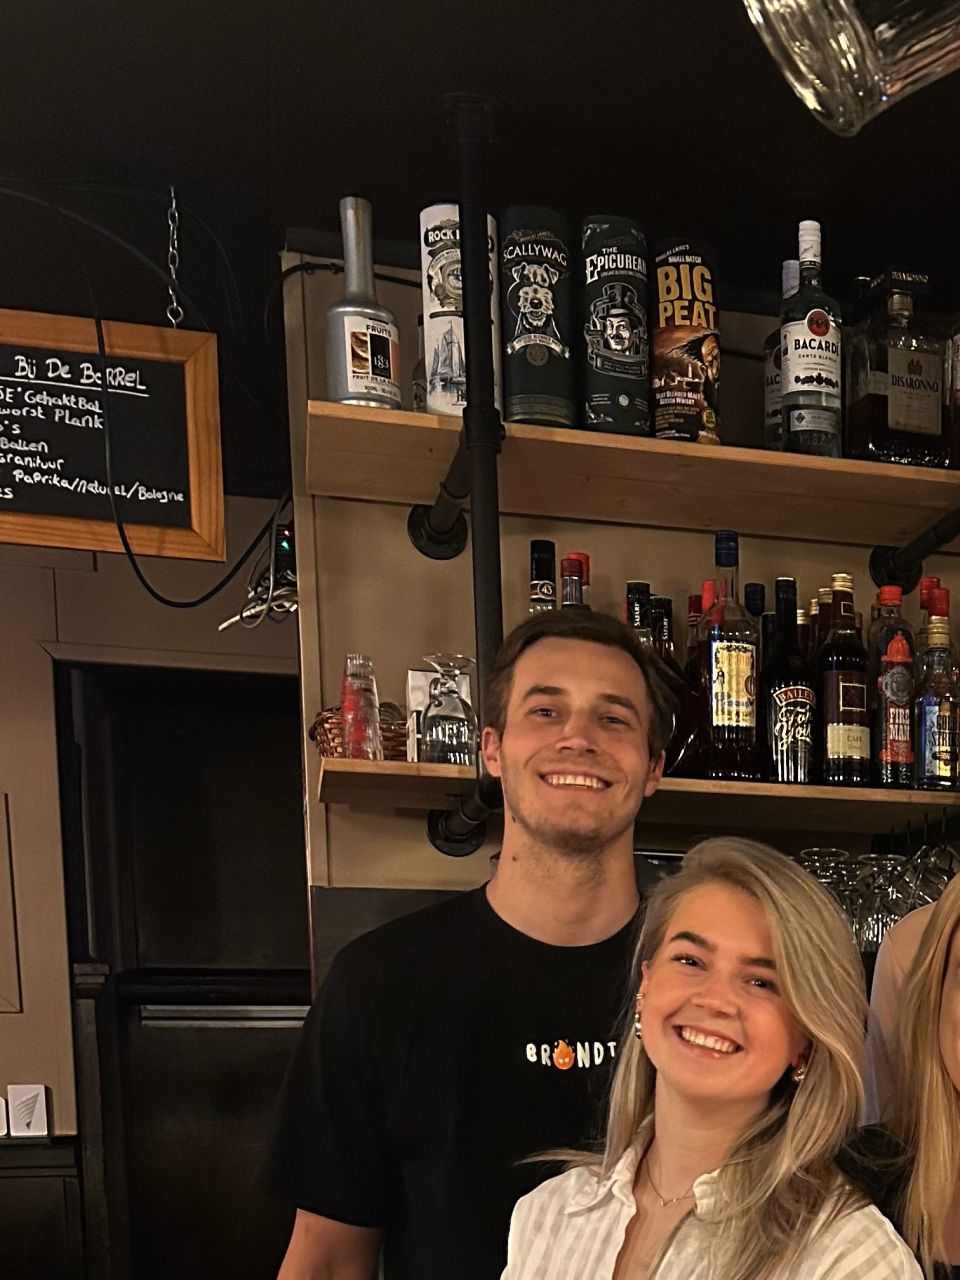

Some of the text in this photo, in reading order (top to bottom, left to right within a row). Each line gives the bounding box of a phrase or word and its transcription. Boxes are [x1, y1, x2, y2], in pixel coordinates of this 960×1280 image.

[428, 229, 454, 243] ROCK
[503, 244, 567, 266] SCALLYWAG
[585, 254, 648, 285] EPICUREAN
[657, 264, 713, 303] BIG
[658, 300, 716, 331] PEAT
[366, 324, 392, 338] FRUITS
[45, 358, 72, 378] De
[891, 374, 939, 394] DISARONNO
[541, 584, 553, 595] 43
[889, 708, 910, 724] FIRE
[889, 724, 910, 741] MAN
